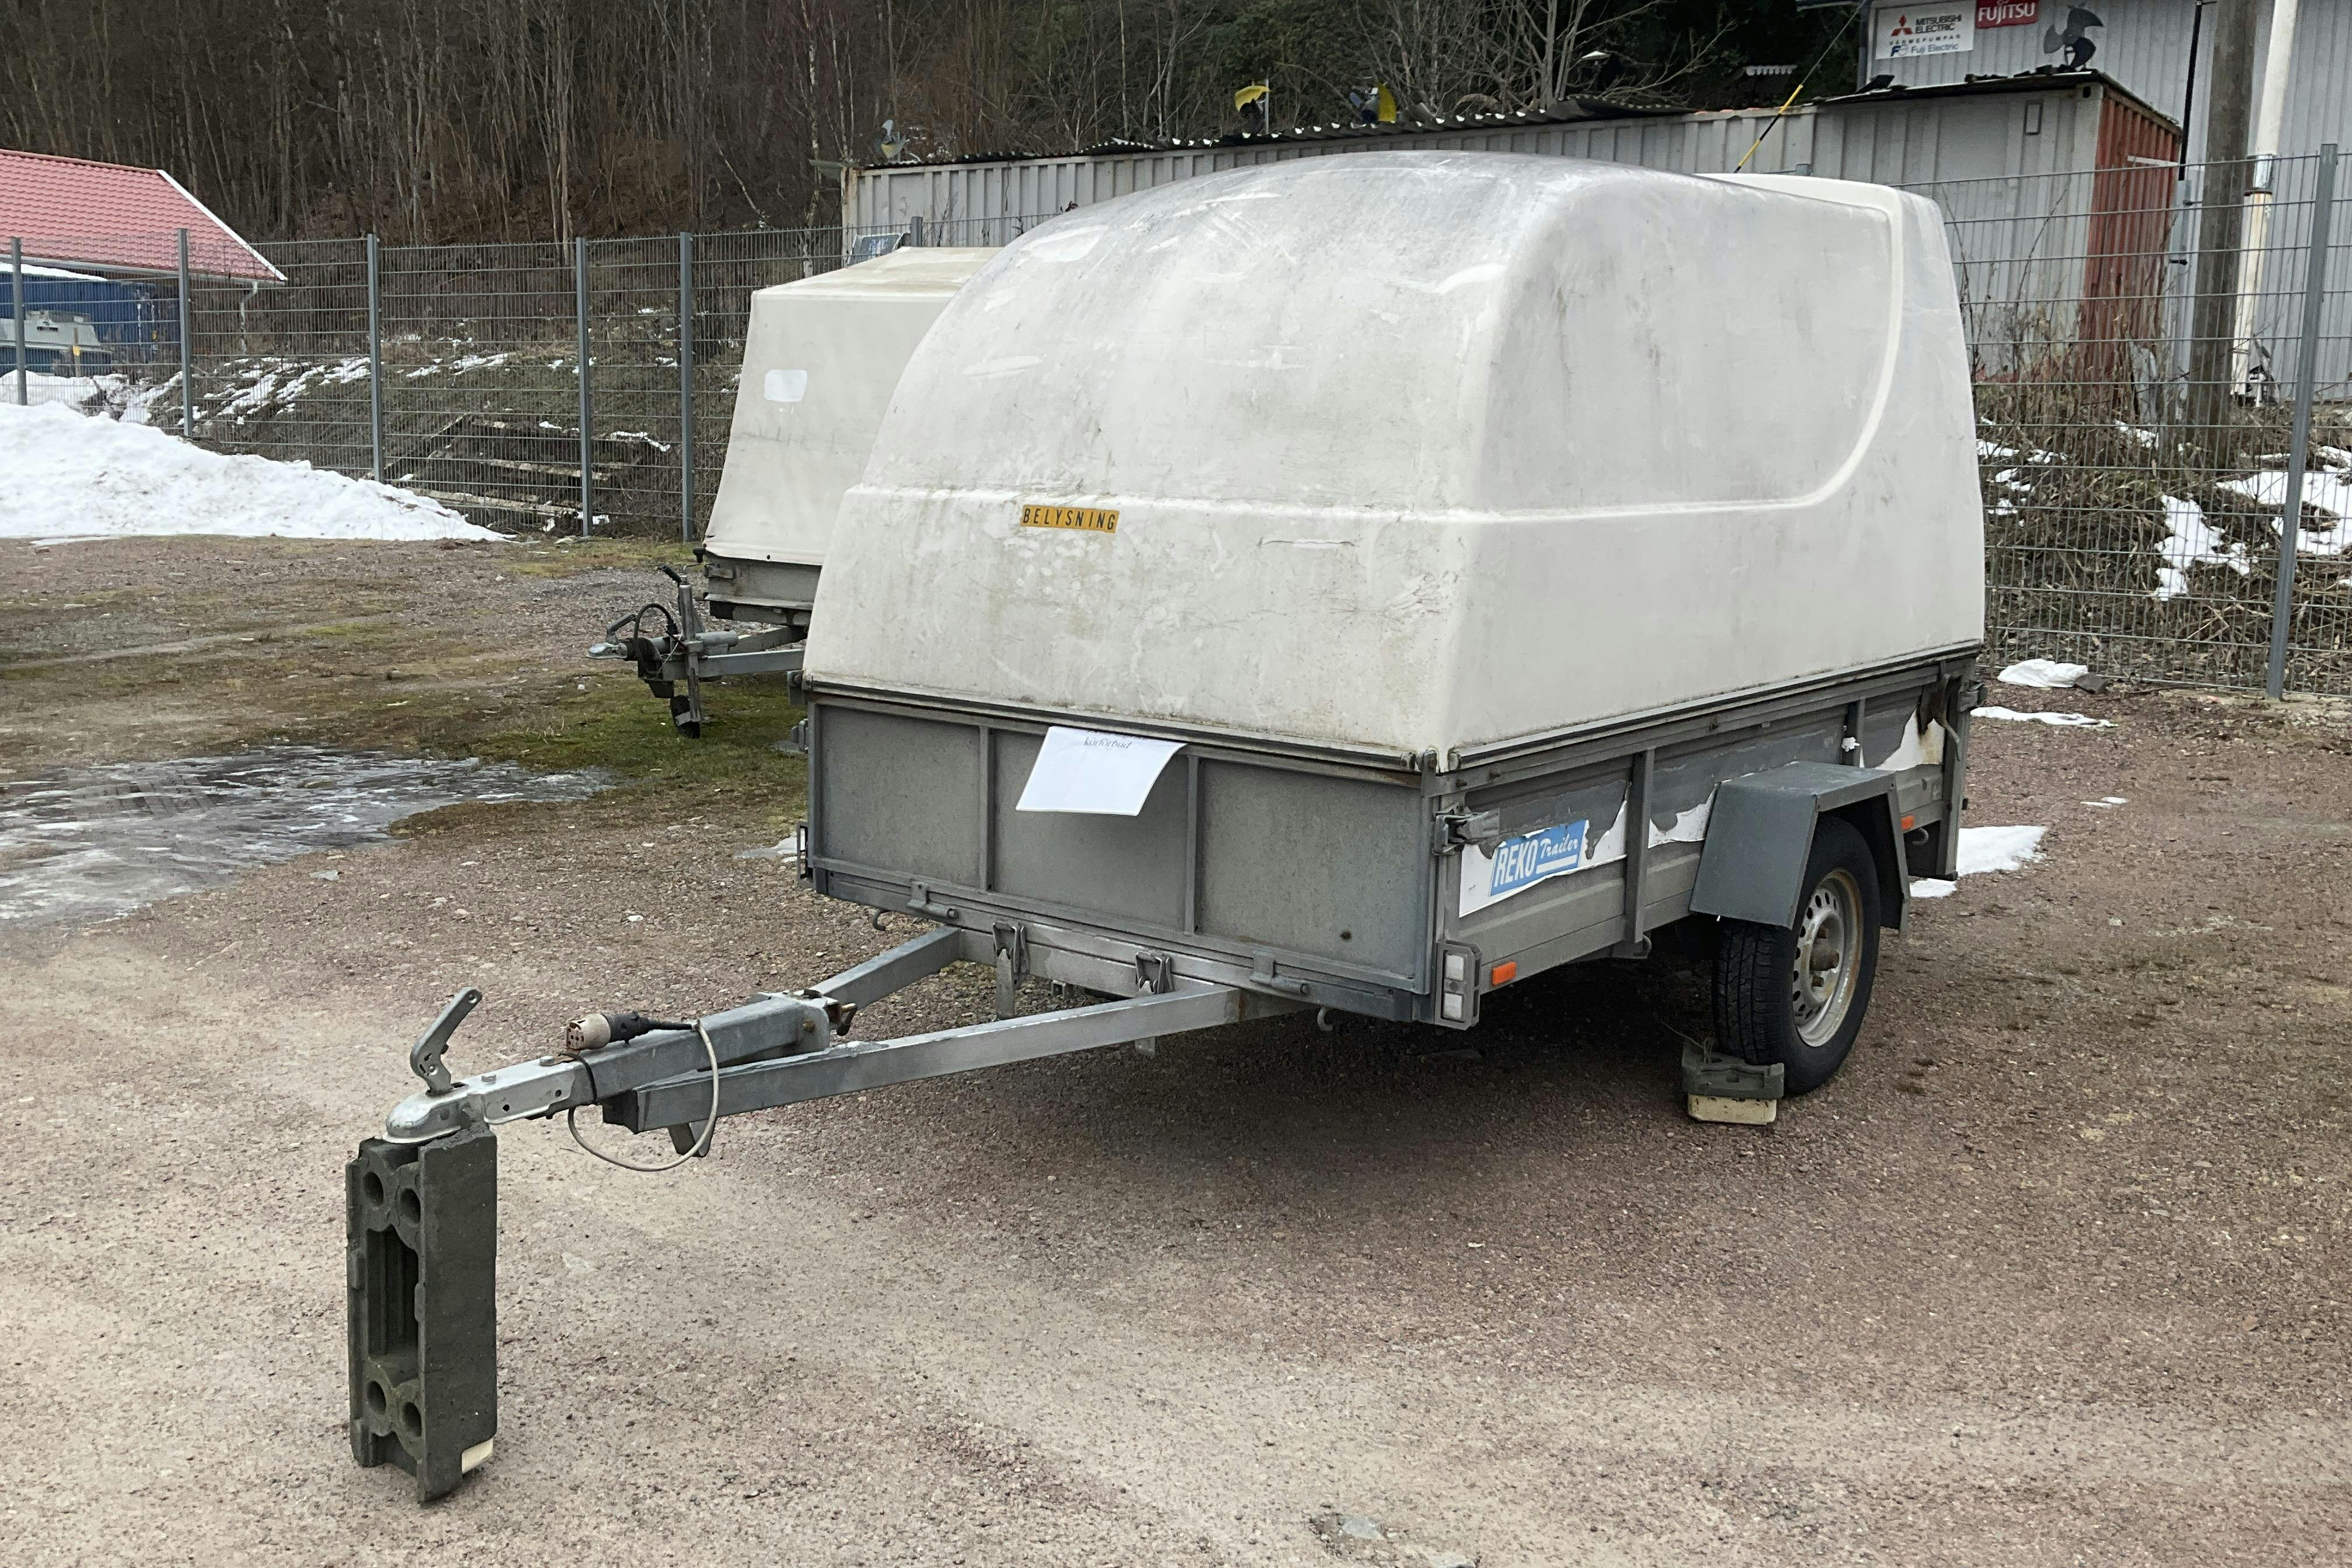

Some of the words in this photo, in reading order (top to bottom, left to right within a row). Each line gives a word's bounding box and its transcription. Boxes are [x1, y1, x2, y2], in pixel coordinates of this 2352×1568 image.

[1916, 14, 1962, 25] MITSUBISHI
[1978, 2, 2035, 24] FUJITSU
[1916, 23, 1955, 34] ELECTRIC
[1928, 44, 1959, 52] Electric
[1023, 508, 1115, 530] BELYSNING
[1494, 839, 1538, 887] REKO
[1540, 834, 1578, 859] Trailer
